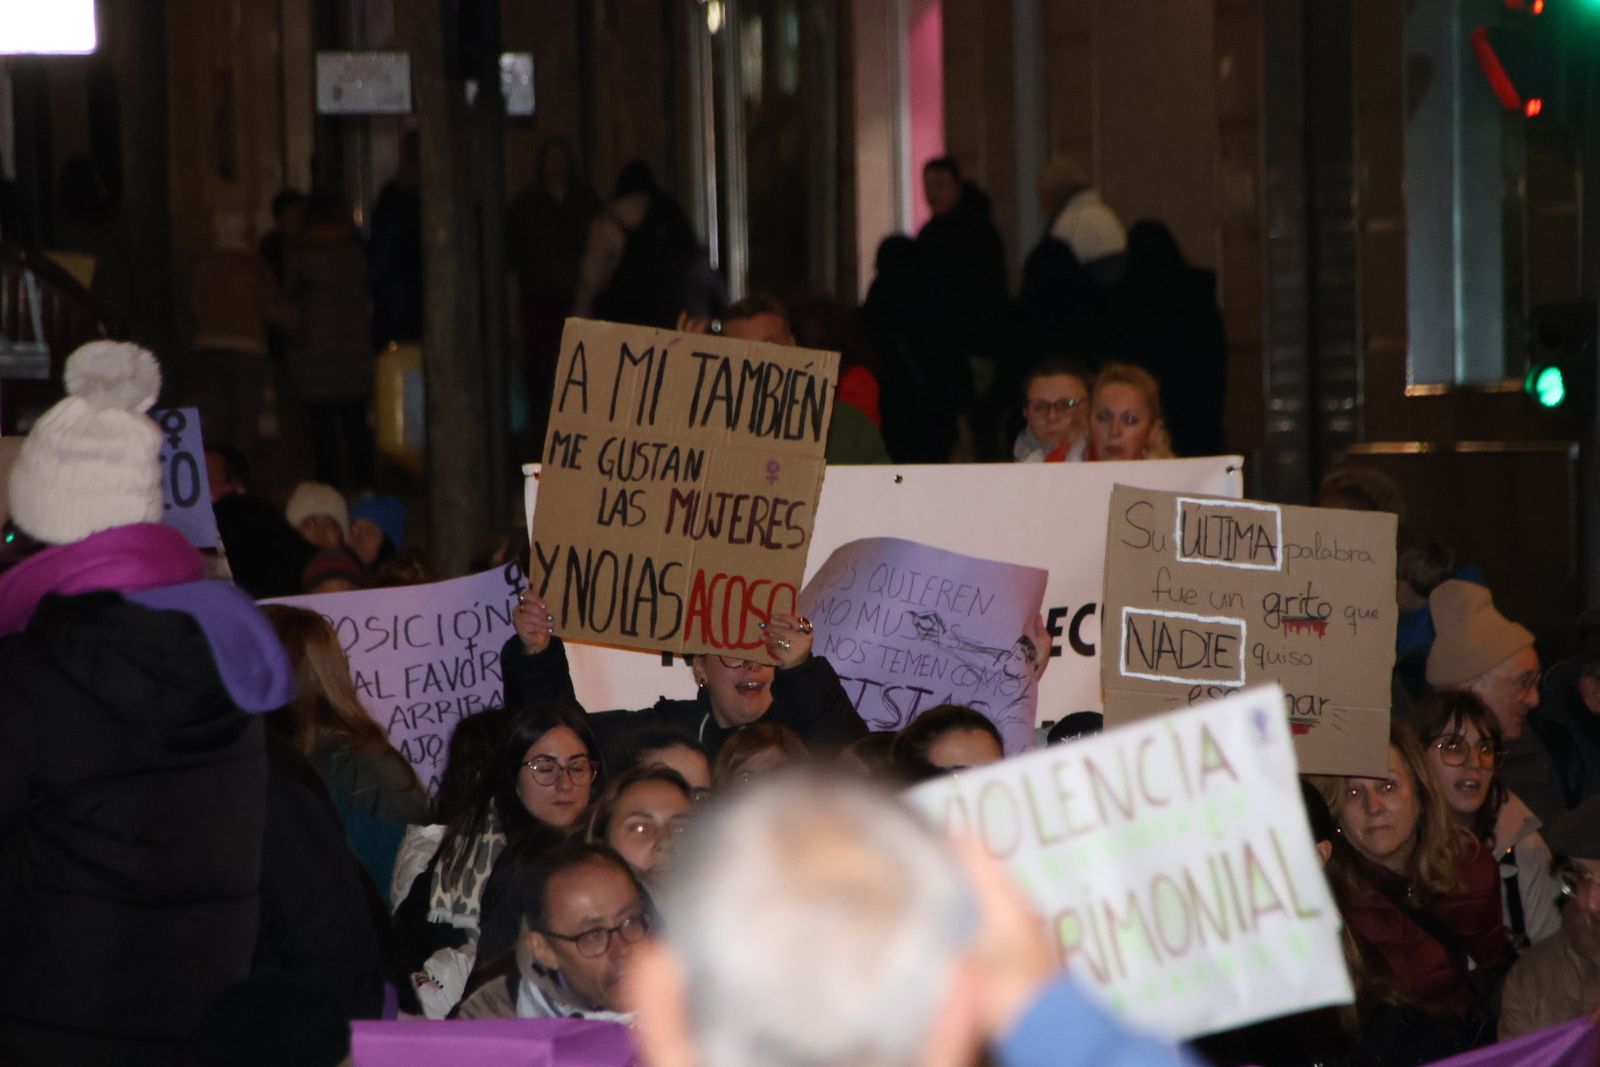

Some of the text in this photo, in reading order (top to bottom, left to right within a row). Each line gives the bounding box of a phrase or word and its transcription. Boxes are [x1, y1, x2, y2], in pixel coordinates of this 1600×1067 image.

[558, 336, 828, 442] A MÍ TAMBIÉN
[548, 430, 704, 482] ME GUSTAN
[598, 487, 805, 549] LAS MUJERES
[1120, 501, 1168, 551] Su
[1284, 531, 1375, 575] palabra
[534, 540, 560, 598] Y
[867, 562, 996, 617] QUIEREN
[1152, 566, 1381, 635] fue un grito que
[824, 633, 1021, 697] NOS TEMEN COMO
[1126, 616, 1313, 671] NADIE quiso
